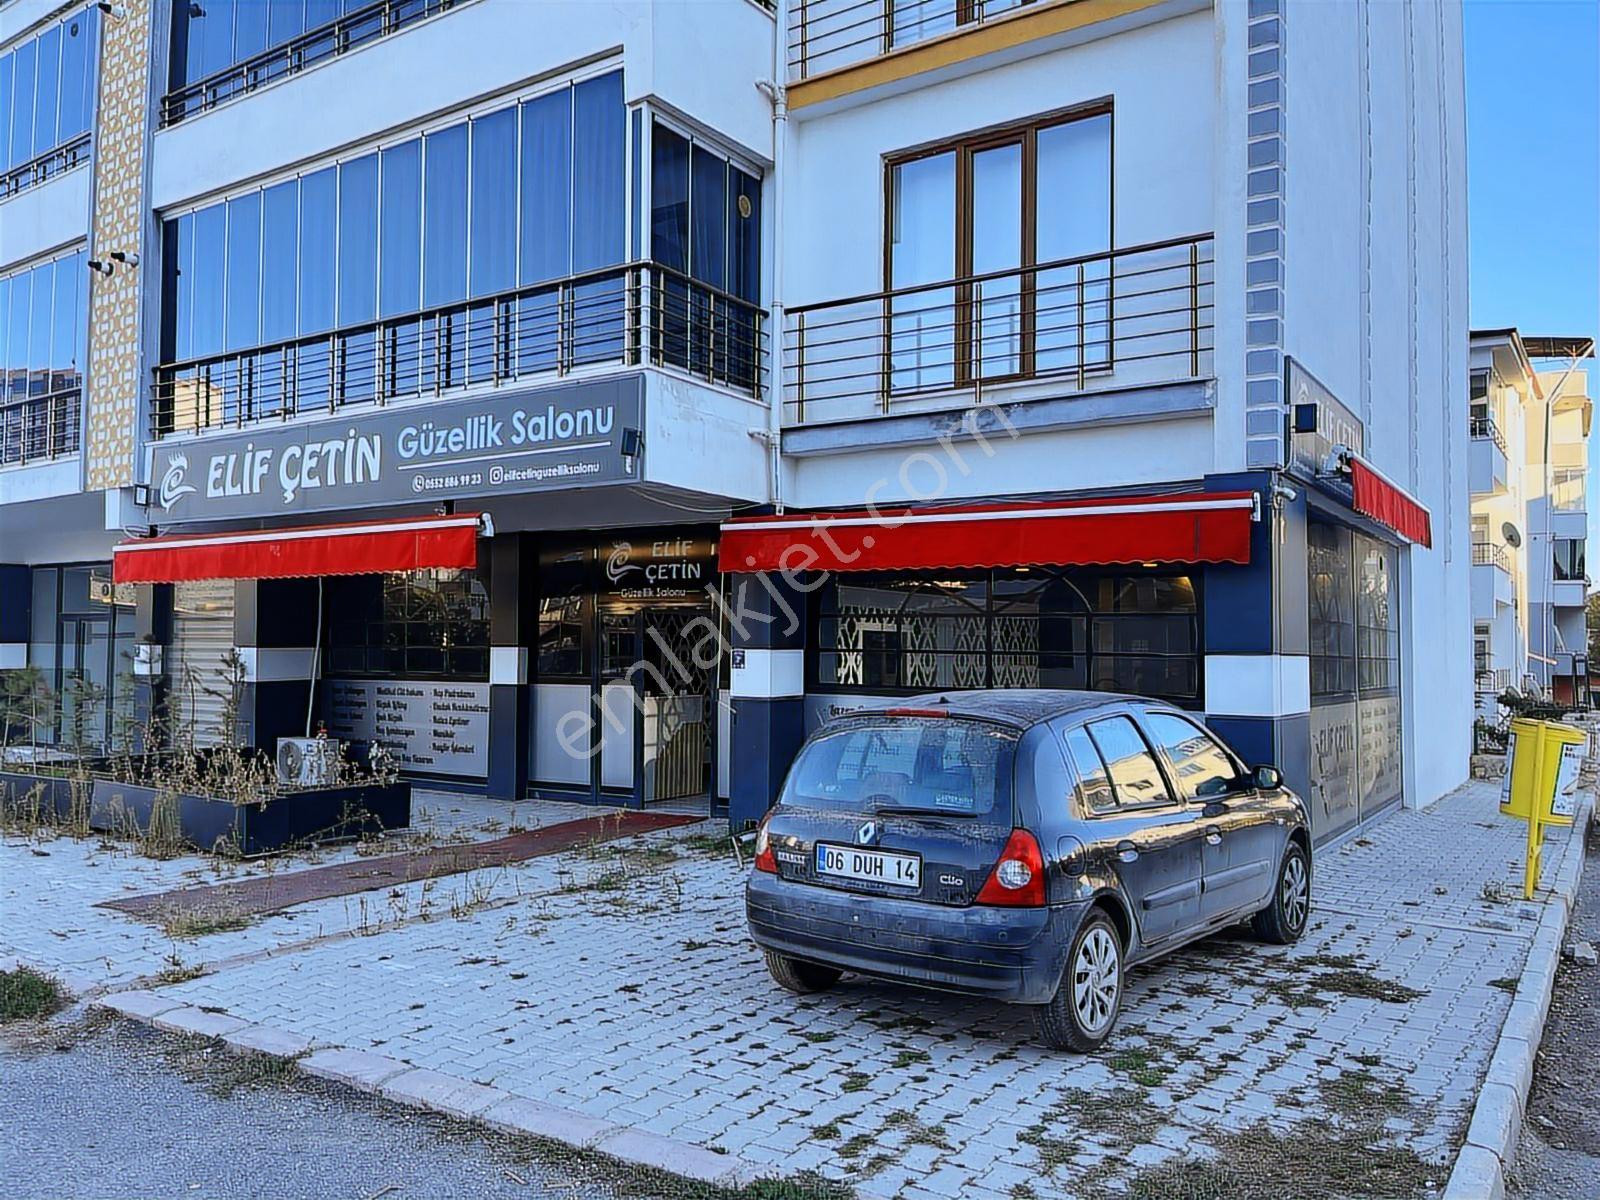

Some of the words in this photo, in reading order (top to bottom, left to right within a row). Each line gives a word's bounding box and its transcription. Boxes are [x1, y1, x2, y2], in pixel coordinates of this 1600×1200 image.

[398, 415, 503, 458] Güzellik
[511, 406, 613, 444] Salonu
[206, 442, 273, 498] ELİF
[279, 428, 381, 504] ÇETİN
[652, 537, 693, 557] ELİF
[645, 560, 700, 584] ÇETİN
[826, 851, 844, 870] 06
[853, 855, 883, 876] DUH
[896, 860, 915, 880] 14
[940, 874, 964, 886] Clio
